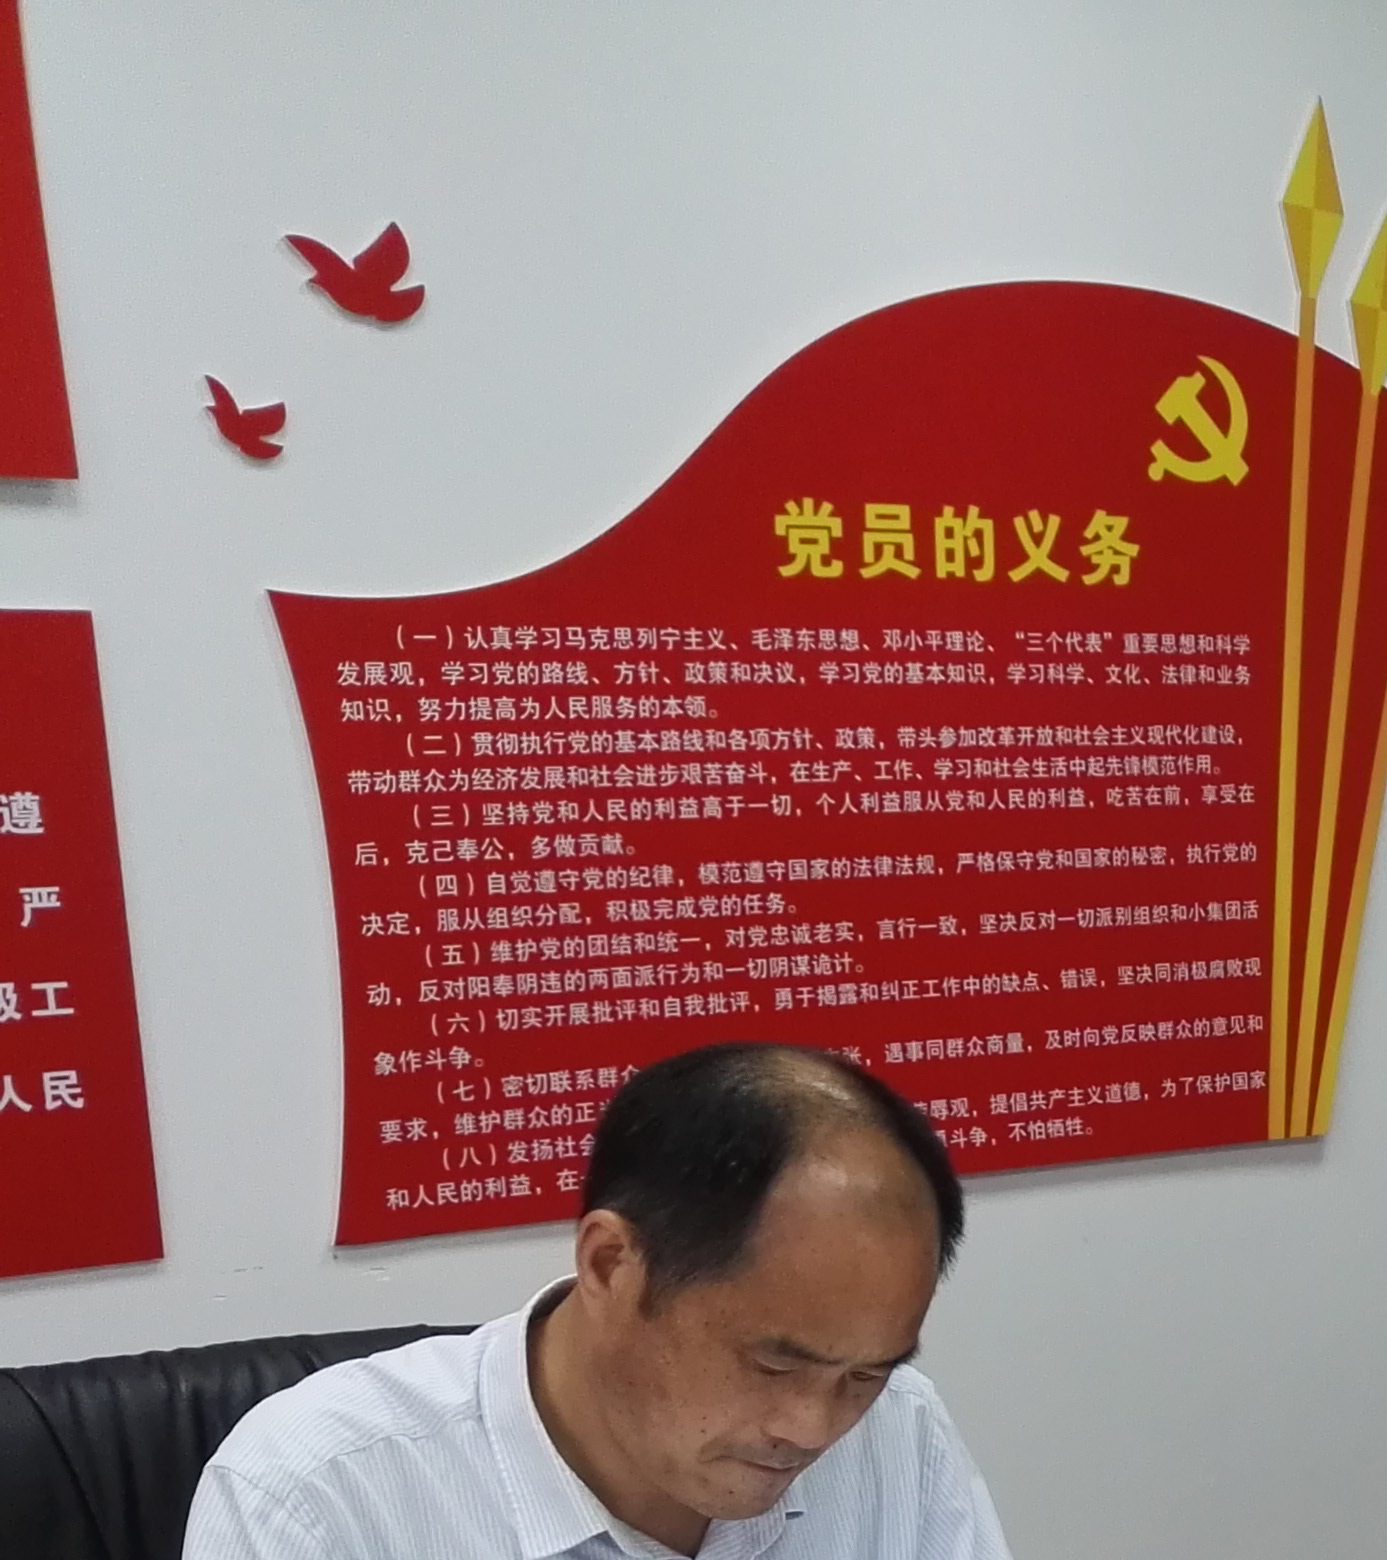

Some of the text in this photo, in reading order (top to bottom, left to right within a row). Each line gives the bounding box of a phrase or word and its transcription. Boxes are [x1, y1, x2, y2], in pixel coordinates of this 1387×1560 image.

[775, 497, 1140, 586] 党员的义务
[341, 695, 717, 722] 知识，努力提高为人民服务的本领。
[0, 791, 44, 834] 遵
[355, 833, 634, 866] 后，克己奉公，多做贡献。
[19, 886, 61, 928] 严
[361, 893, 795, 936] 决定，服从组织分配，积极完成党的任务。
[374, 1046, 482, 1075] 象作斗争。
